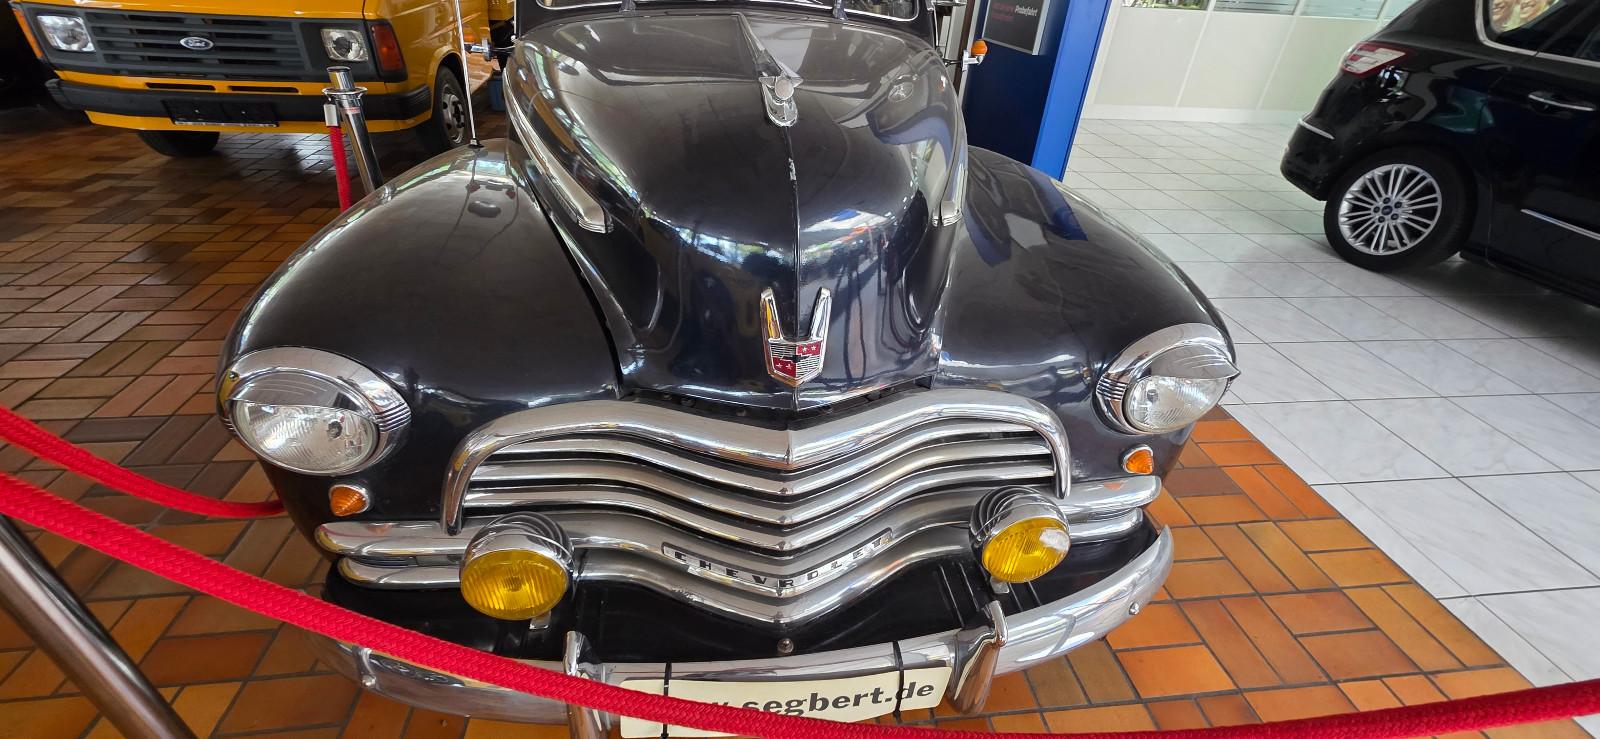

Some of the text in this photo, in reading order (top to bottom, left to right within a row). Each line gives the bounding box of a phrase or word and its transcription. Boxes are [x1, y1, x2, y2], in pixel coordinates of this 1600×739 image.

[184, 38, 208, 48] Ford
[674, 537, 882, 588] CHEVROLET
[711, 681, 935, 717] segbert.de
